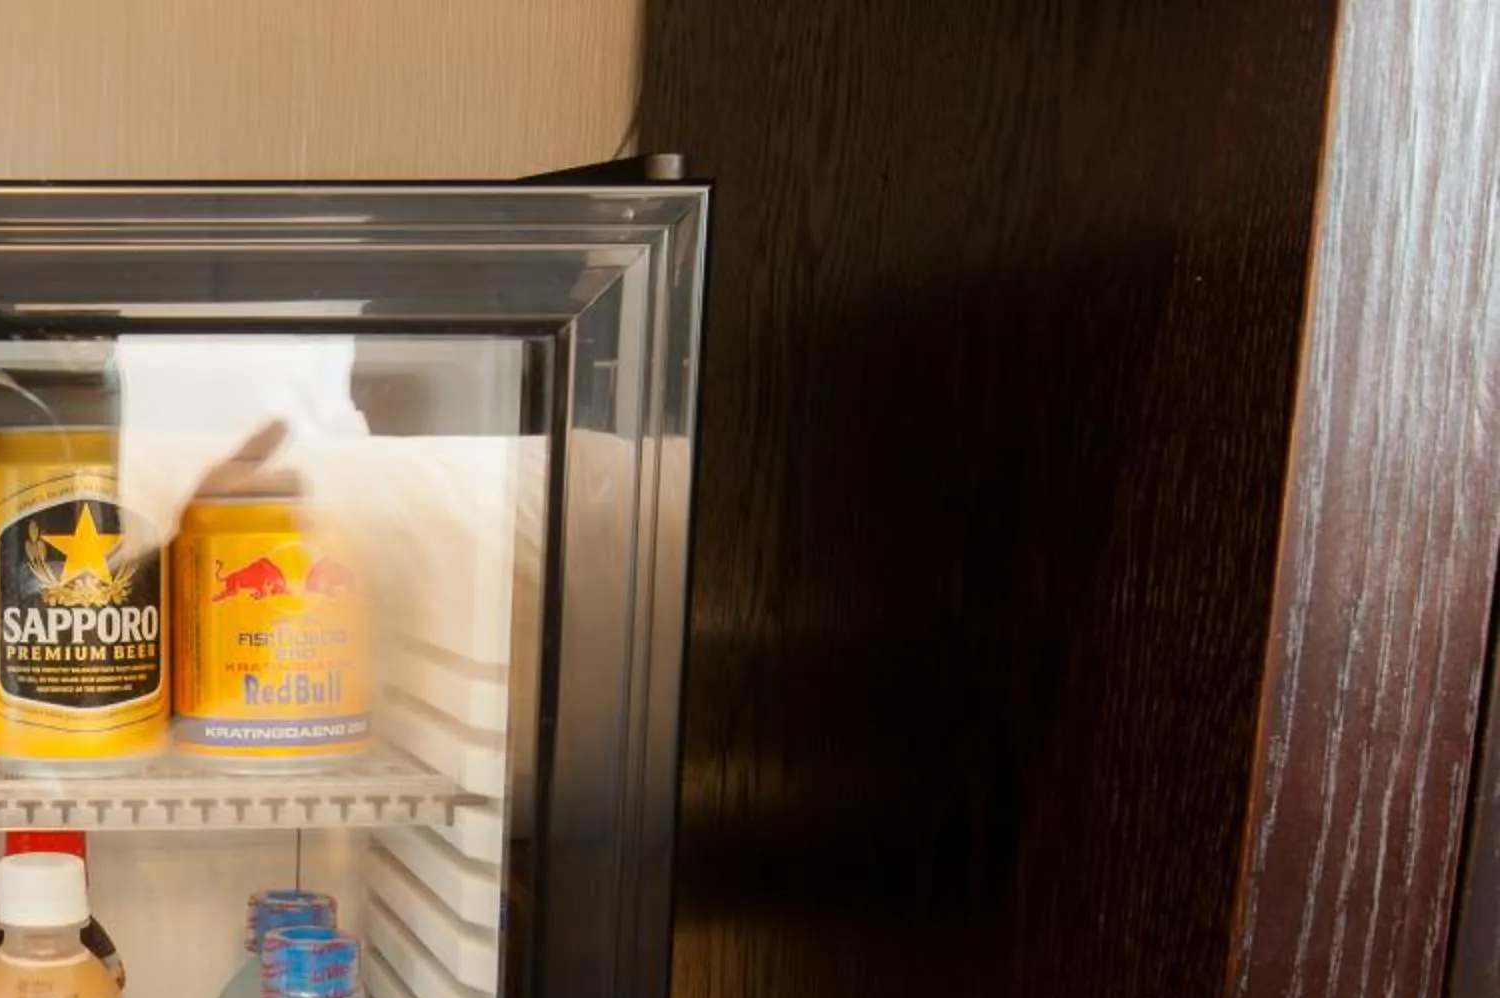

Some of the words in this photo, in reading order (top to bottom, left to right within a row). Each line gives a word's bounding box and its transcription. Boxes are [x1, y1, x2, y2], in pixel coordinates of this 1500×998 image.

[3, 605, 159, 645] SAPPORO
[6, 645, 107, 661] PREMIUM
[113, 643, 156, 660] BEER
